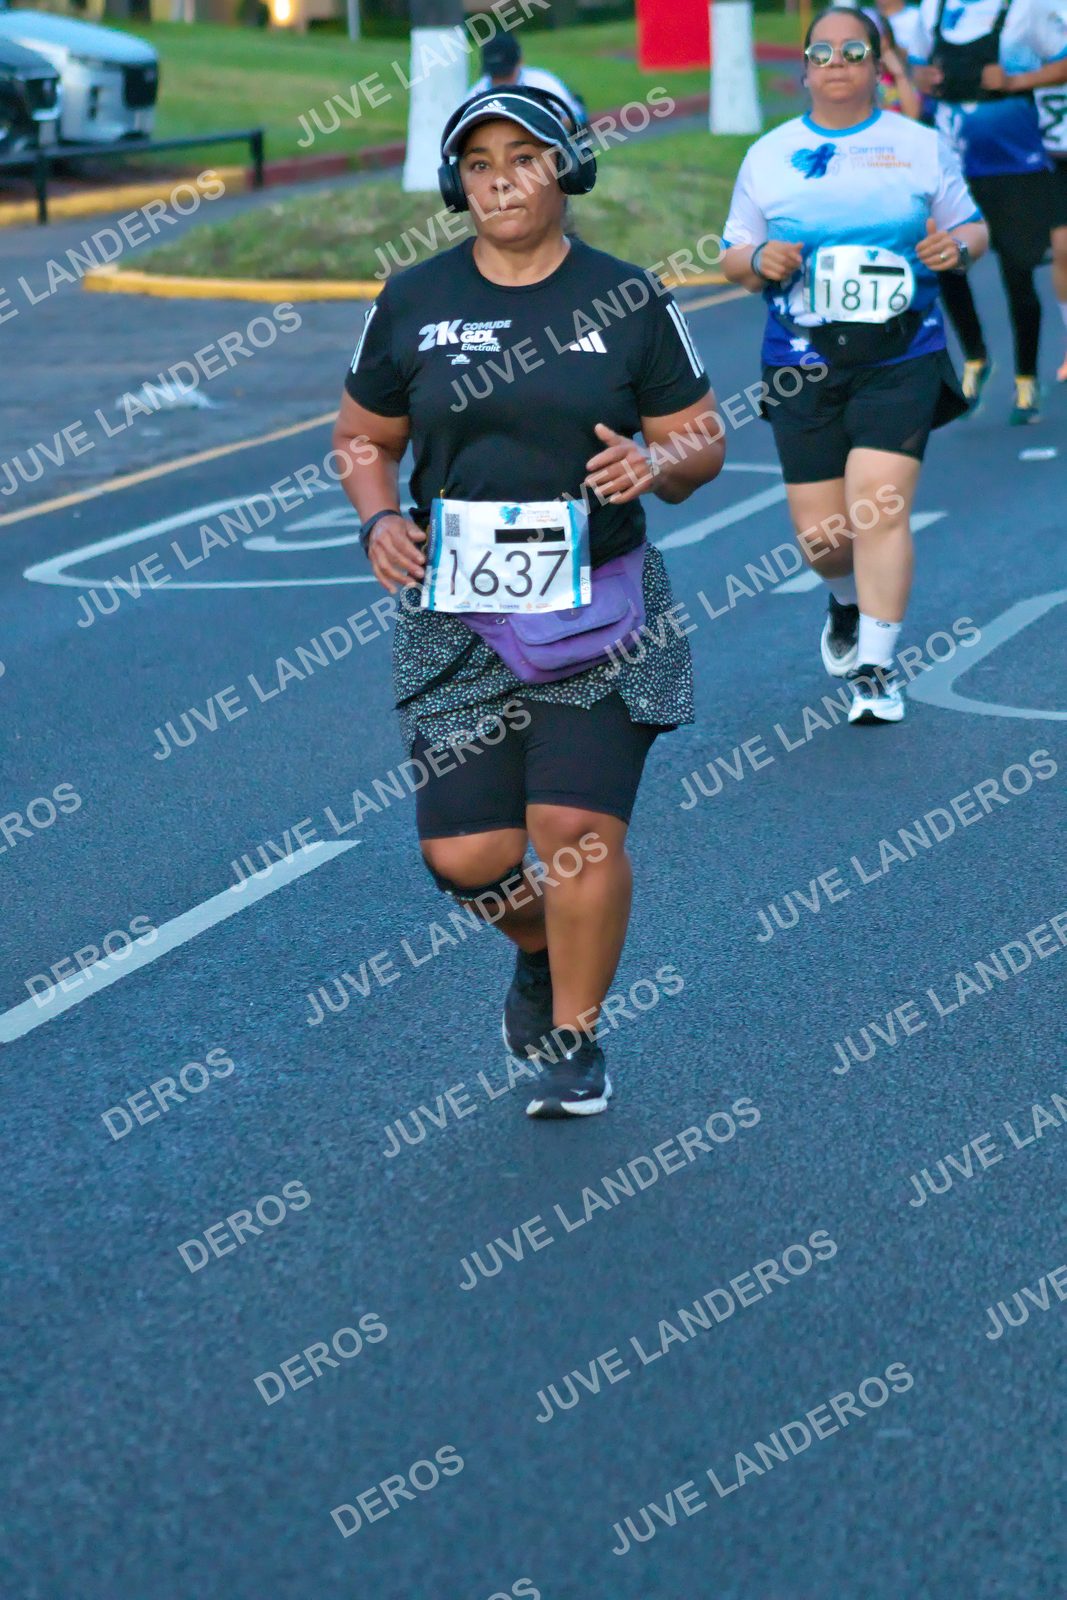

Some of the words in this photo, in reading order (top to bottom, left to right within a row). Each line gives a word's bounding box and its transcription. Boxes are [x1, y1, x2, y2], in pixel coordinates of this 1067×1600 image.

[823, 278, 909, 312] 1816
[460, 330, 498, 343] GDL
[462, 320, 512, 331] COMUDE
[449, 549, 570, 598] 1637
